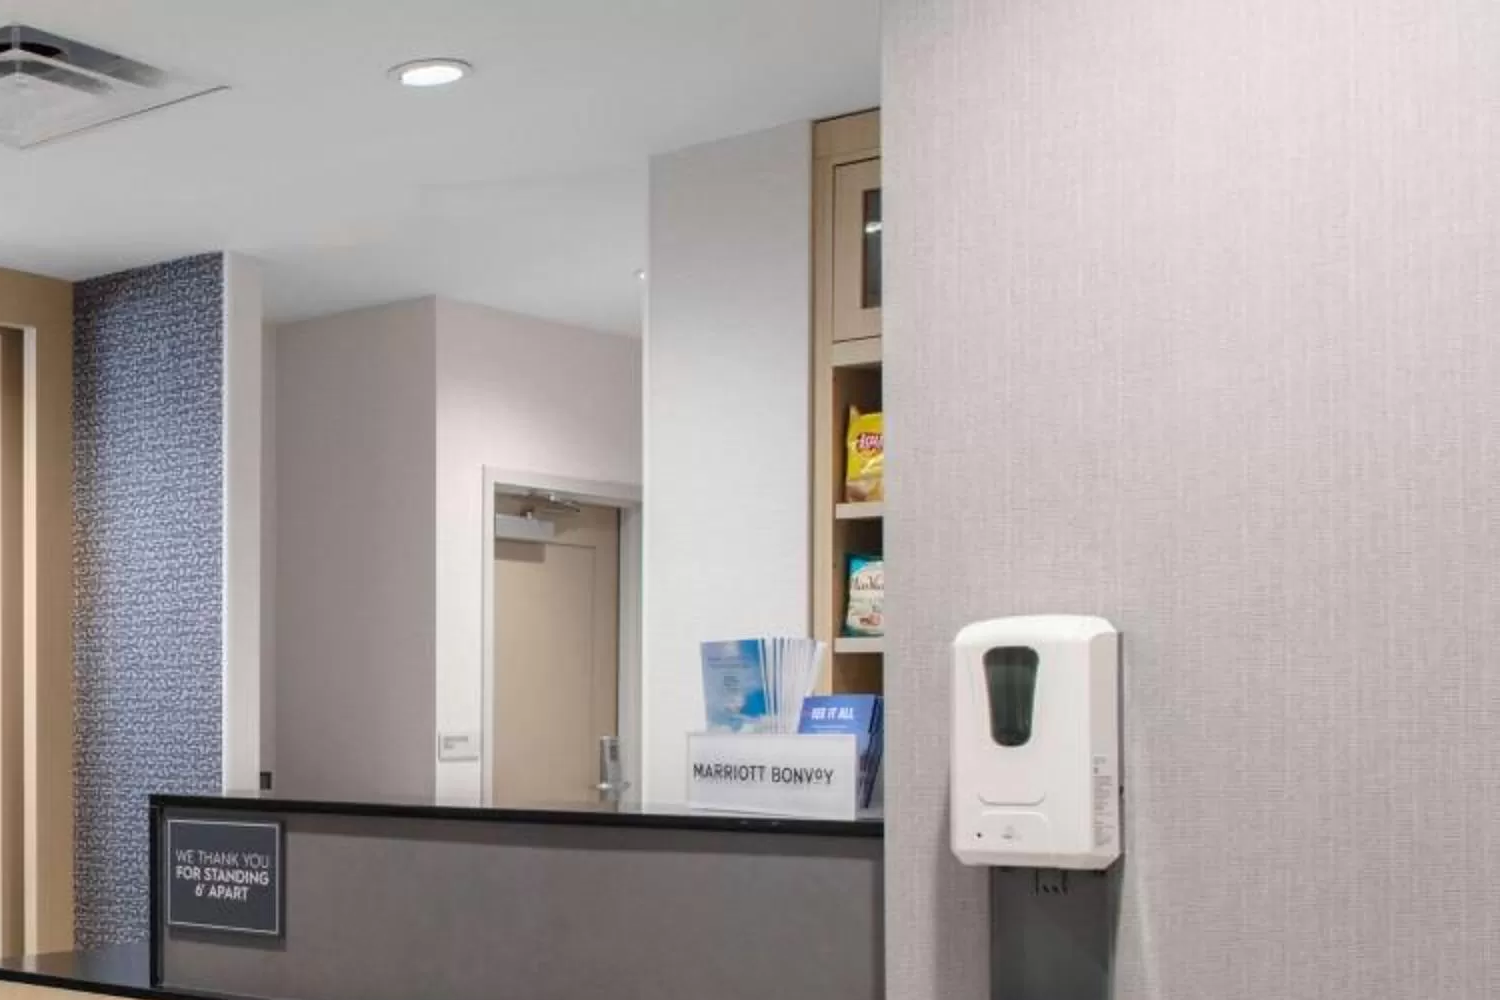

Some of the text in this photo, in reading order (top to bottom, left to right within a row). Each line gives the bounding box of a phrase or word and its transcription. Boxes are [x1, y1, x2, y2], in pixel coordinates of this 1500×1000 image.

[693, 763, 834, 785] MARRIOTT BONVOY
[176, 849, 269, 869] WE THANK YOU
[176, 866, 270, 886] FOR STANDING
[207, 884, 250, 902] APART
